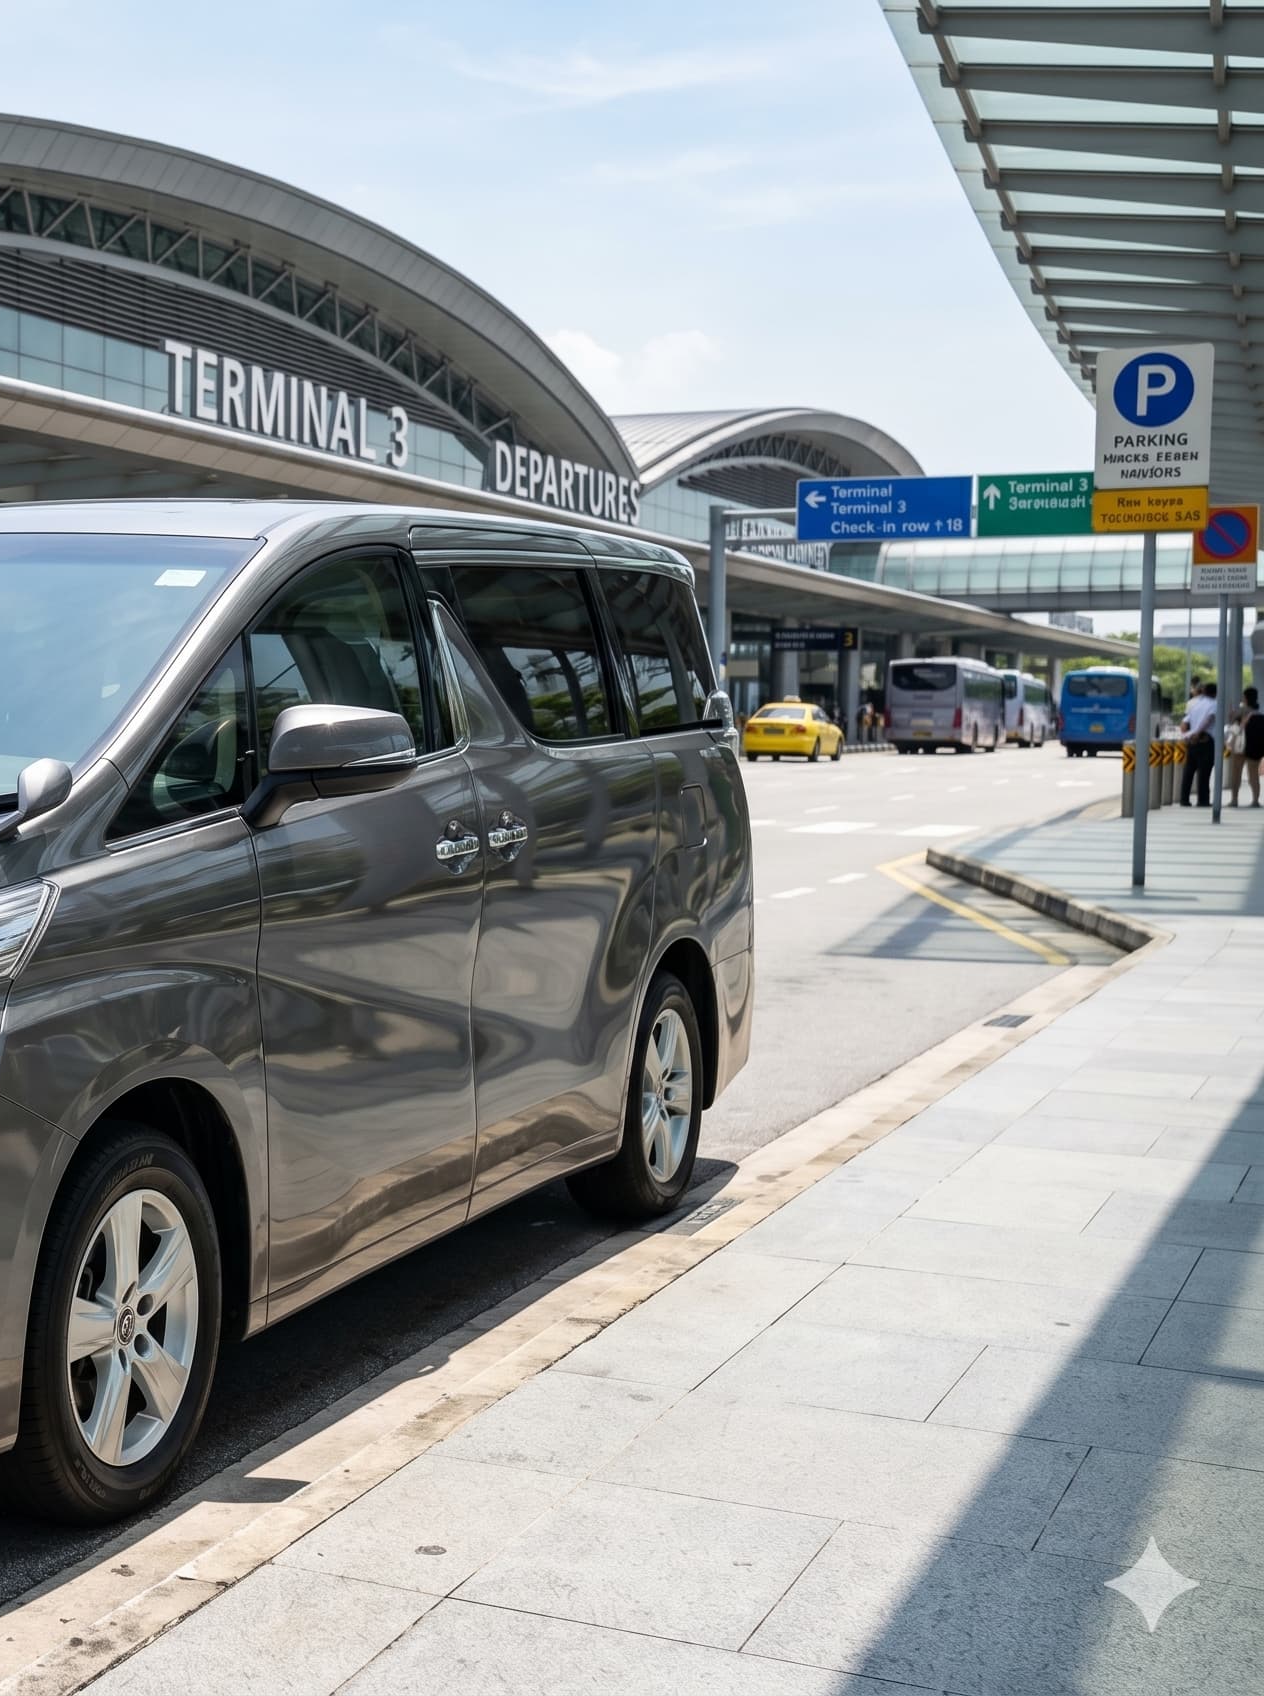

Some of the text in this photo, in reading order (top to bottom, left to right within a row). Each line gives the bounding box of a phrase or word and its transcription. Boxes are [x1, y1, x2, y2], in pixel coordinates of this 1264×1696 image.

[1136, 364, 1176, 416] P
[163, 339, 410, 470] TERMINAL 3
[1114, 432, 1188, 448] PARKING
[495, 439, 641, 526] DEPARTURES
[1008, 478, 1089, 494] Terminal 3
[830, 484, 892, 499] Terminal
[830, 500, 907, 515] Terminal 3
[830, 520, 896, 534] Check-in
[902, 521, 930, 533] row
